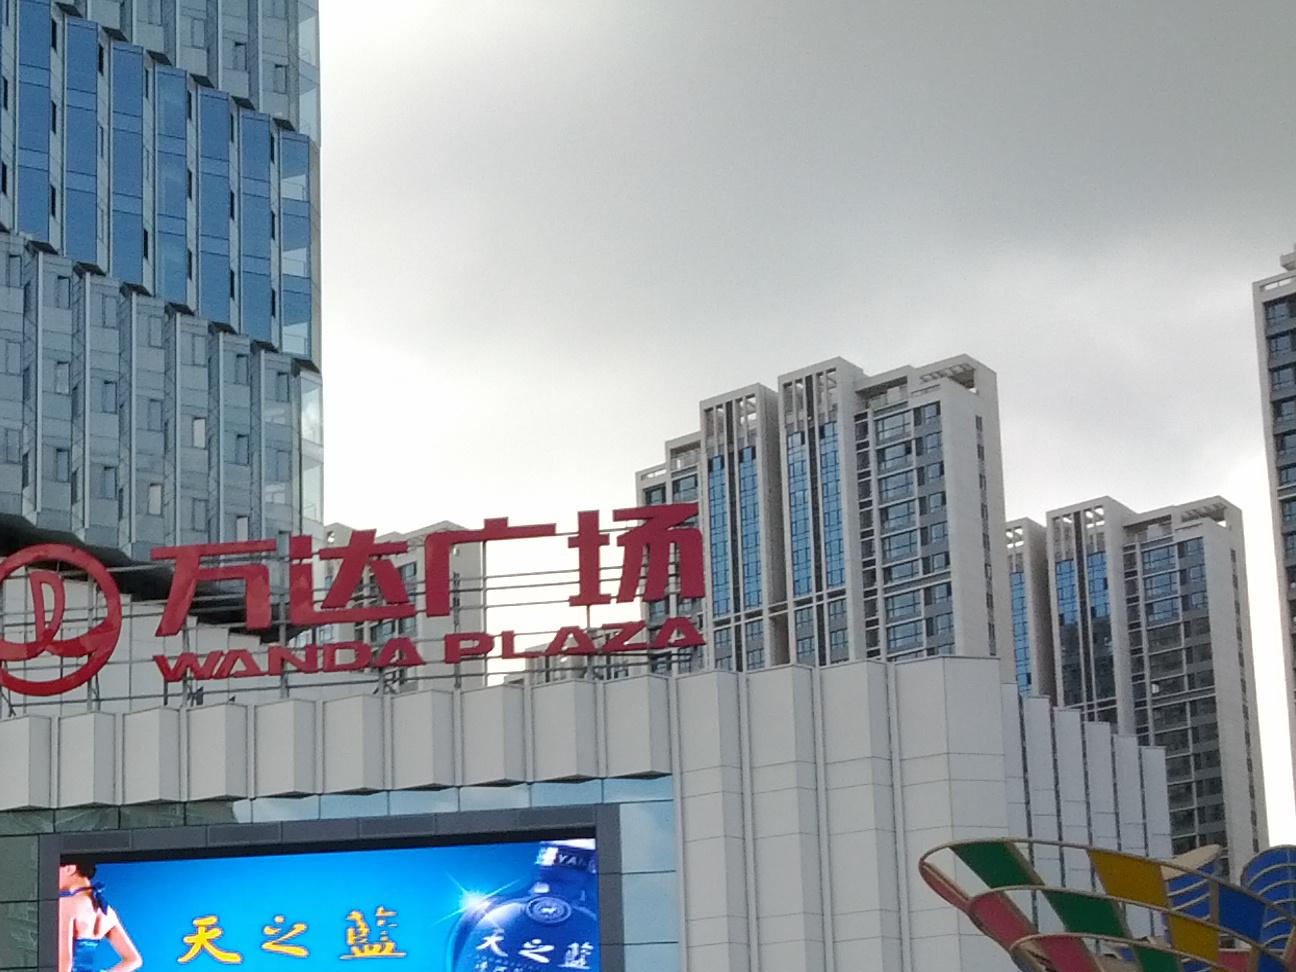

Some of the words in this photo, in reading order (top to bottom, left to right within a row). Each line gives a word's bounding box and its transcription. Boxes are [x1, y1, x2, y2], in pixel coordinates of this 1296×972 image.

[149, 501, 706, 637] 万达广场
[152, 636, 425, 683] WANDA
[443, 616, 707, 665] PLAZA
